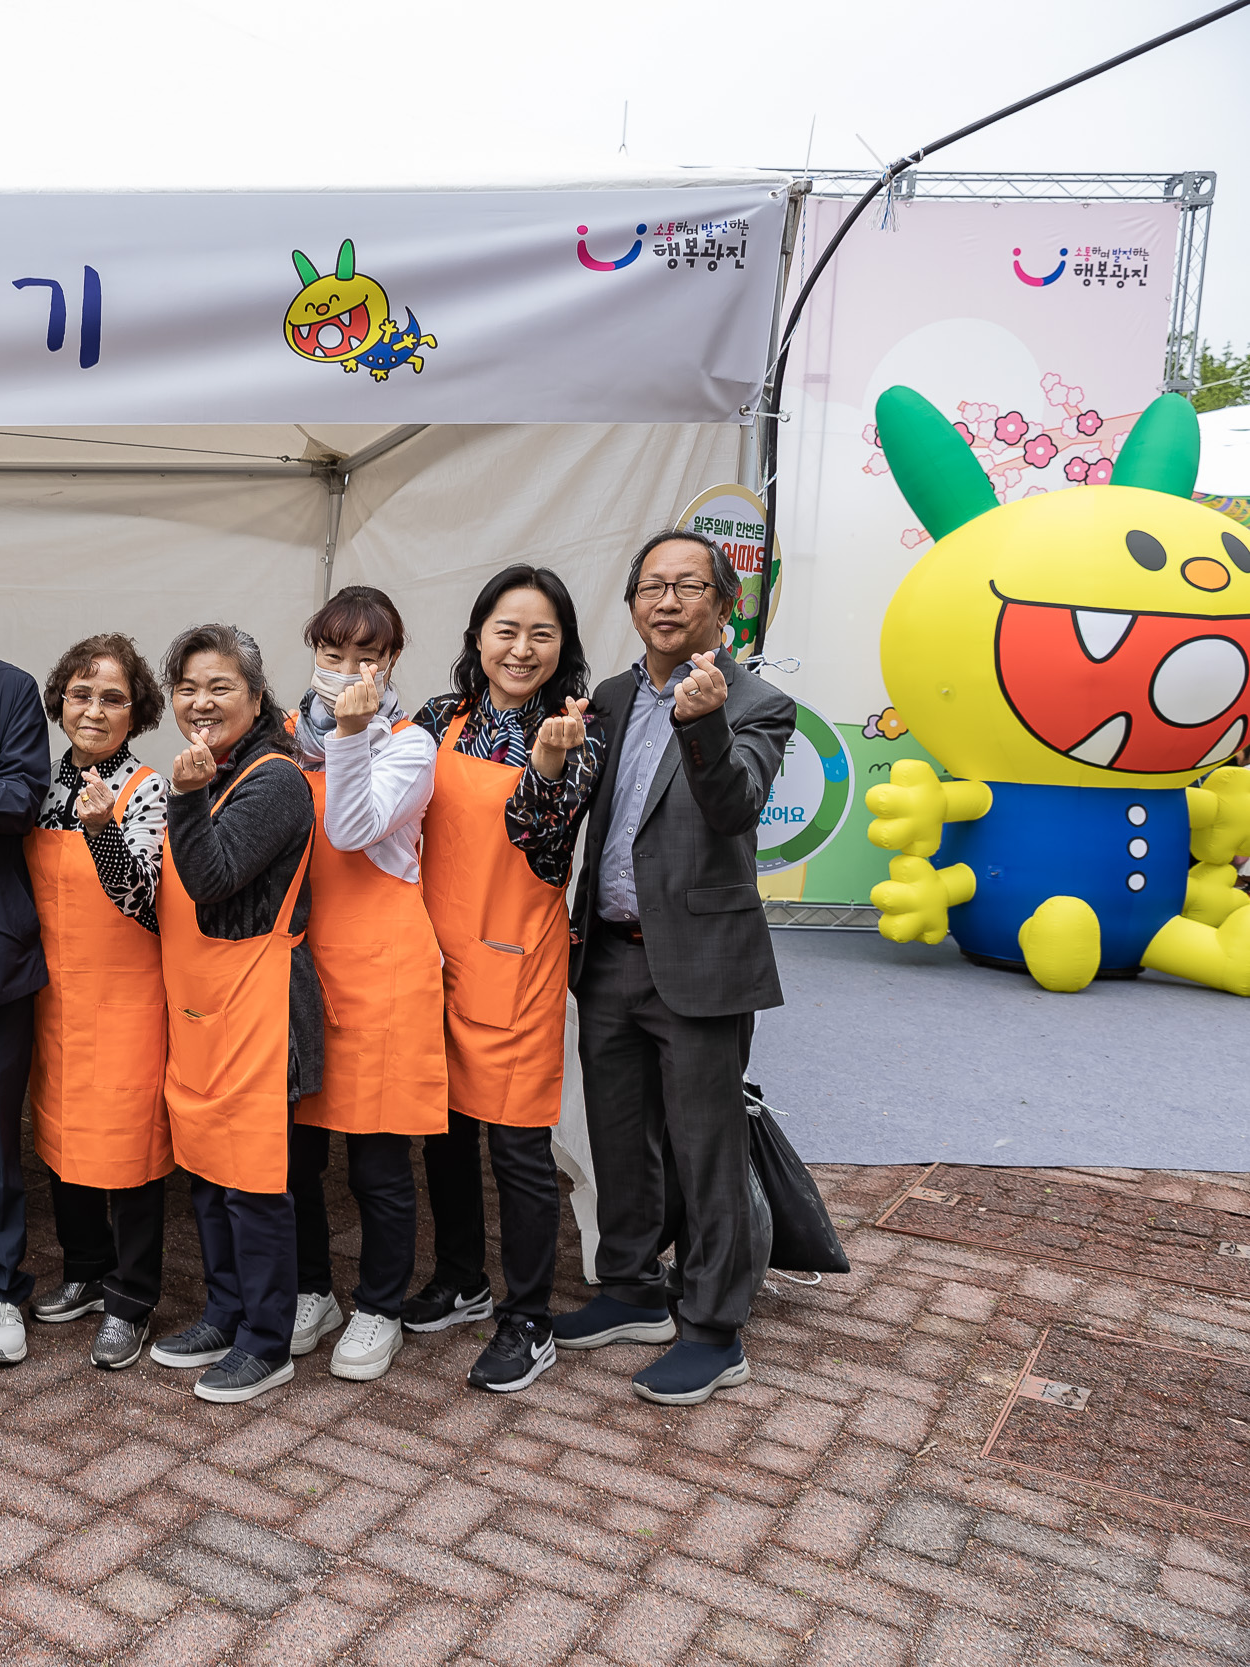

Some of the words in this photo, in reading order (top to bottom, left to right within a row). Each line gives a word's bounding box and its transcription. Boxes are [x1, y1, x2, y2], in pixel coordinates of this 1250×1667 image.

[654, 221, 698, 242] 소통하며
[702, 219, 749, 237] 발전하는
[653, 237, 747, 272] 행복광진
[1074, 246, 1110, 262] 소통하며
[1112, 247, 1149, 263] 발전하는
[1073, 261, 1148, 289] 행복광진
[693, 515, 734, 537] 일주일에
[735, 521, 765, 541] 한번은
